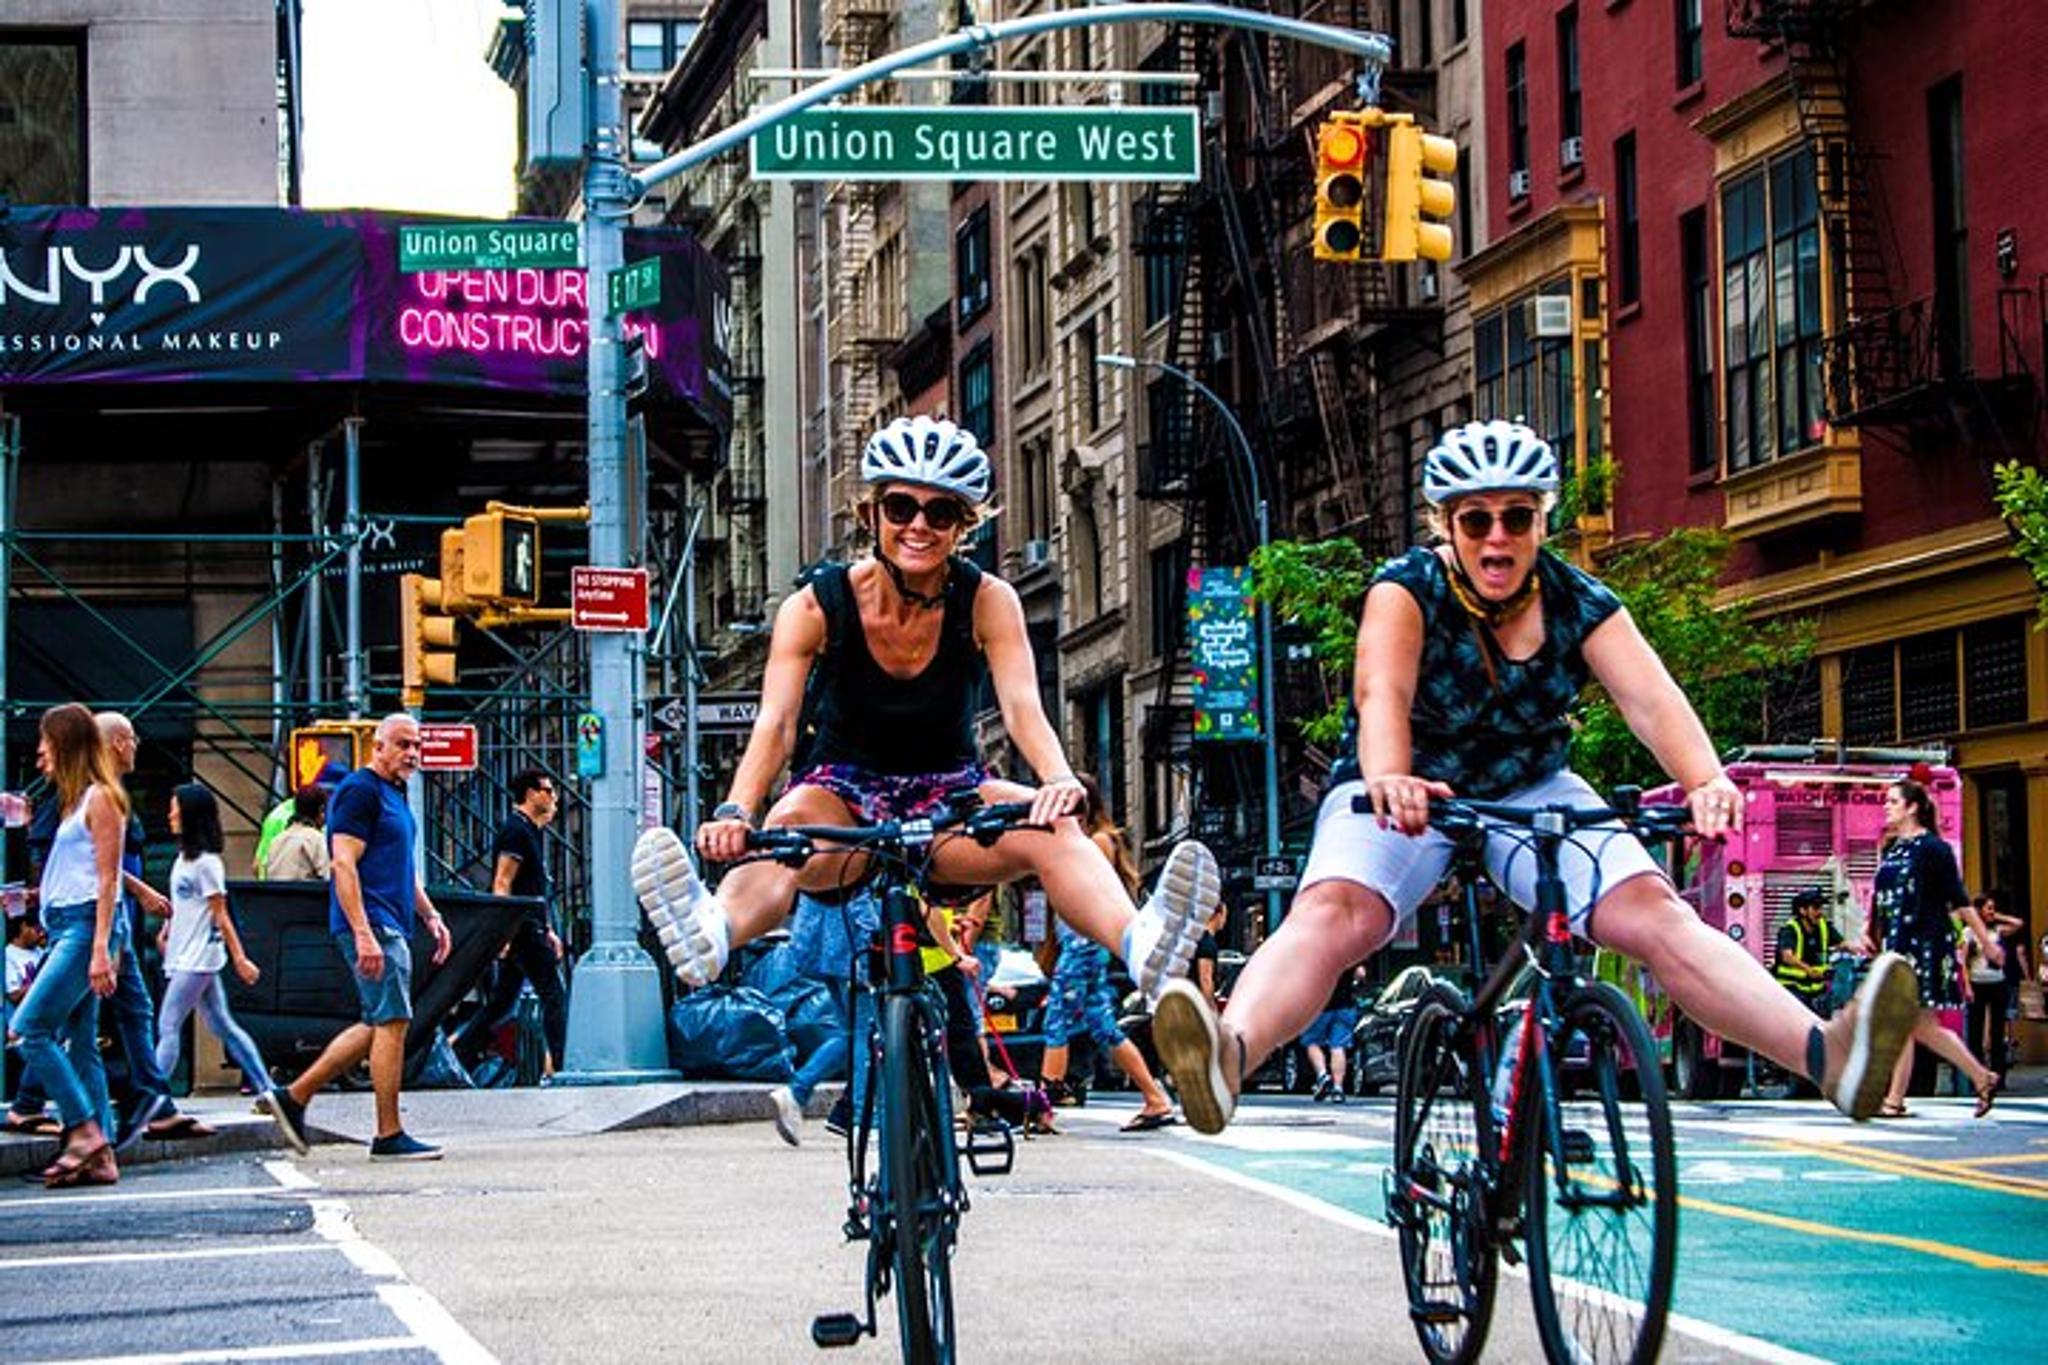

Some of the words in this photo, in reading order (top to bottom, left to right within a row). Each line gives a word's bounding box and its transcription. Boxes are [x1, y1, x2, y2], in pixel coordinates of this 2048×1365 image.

[774, 121, 895, 160] Union
[914, 123, 1057, 169] Square
[1078, 124, 1177, 161] West
[405, 230, 478, 255] Union
[488, 229, 575, 258] Square
[0, 244, 201, 304] NYX
[417, 268, 508, 302] OPEN
[517, 268, 590, 308] DURI
[613, 273, 621, 308] E
[625, 269, 639, 304] 17
[162, 331, 281, 350] MAKEUP
[717, 704, 757, 720] WAY
